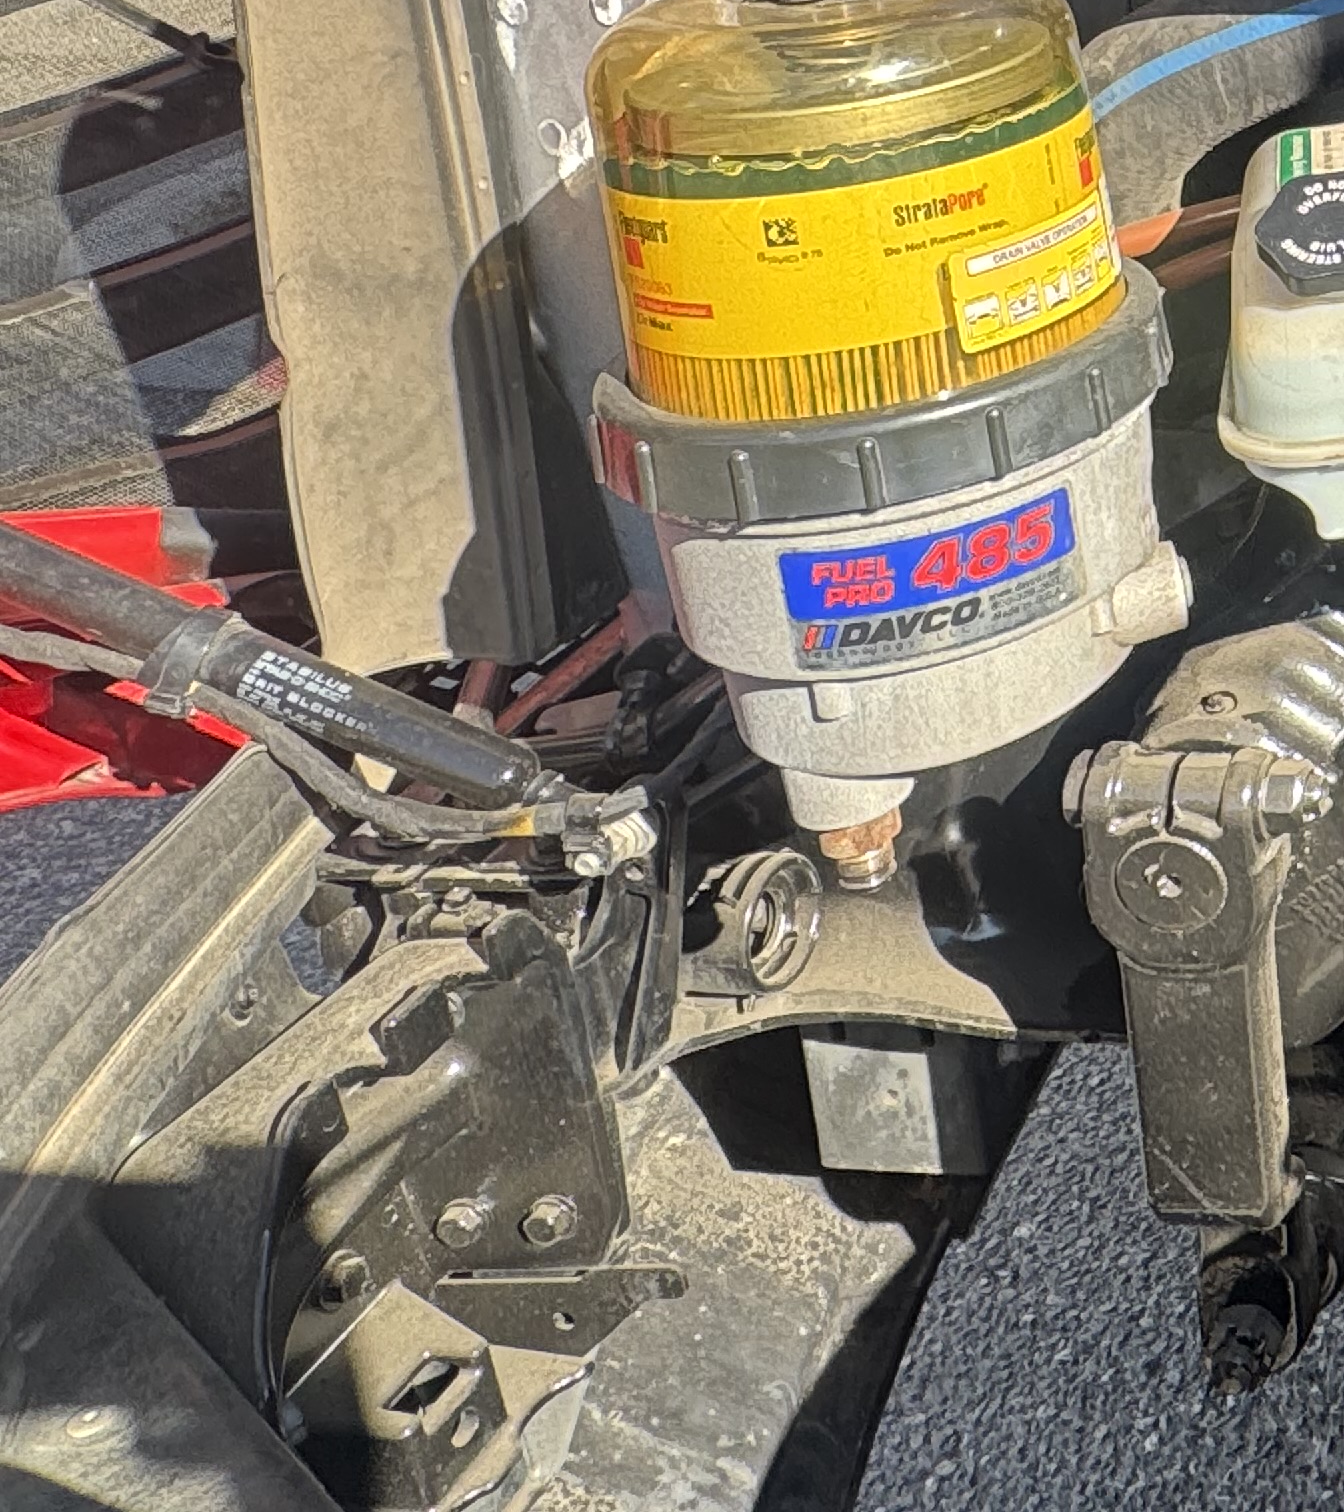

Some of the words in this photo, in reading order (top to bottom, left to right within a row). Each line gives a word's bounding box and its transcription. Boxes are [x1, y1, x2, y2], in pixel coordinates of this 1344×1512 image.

[1303, 182, 1324, 196] DO
[893, 187, 986, 228] StrataPore
[883, 246, 902, 259] Do
[904, 237, 928, 253] Not
[929, 227, 976, 248] Remove
[1280, 238, 1342, 266] STEERING
[911, 498, 1055, 593] 485
[811, 555, 895, 586] FUEL
[823, 580, 895, 609] PRO
[838, 596, 982, 648] DAVCO
[260, 650, 352, 694] STABILUS
